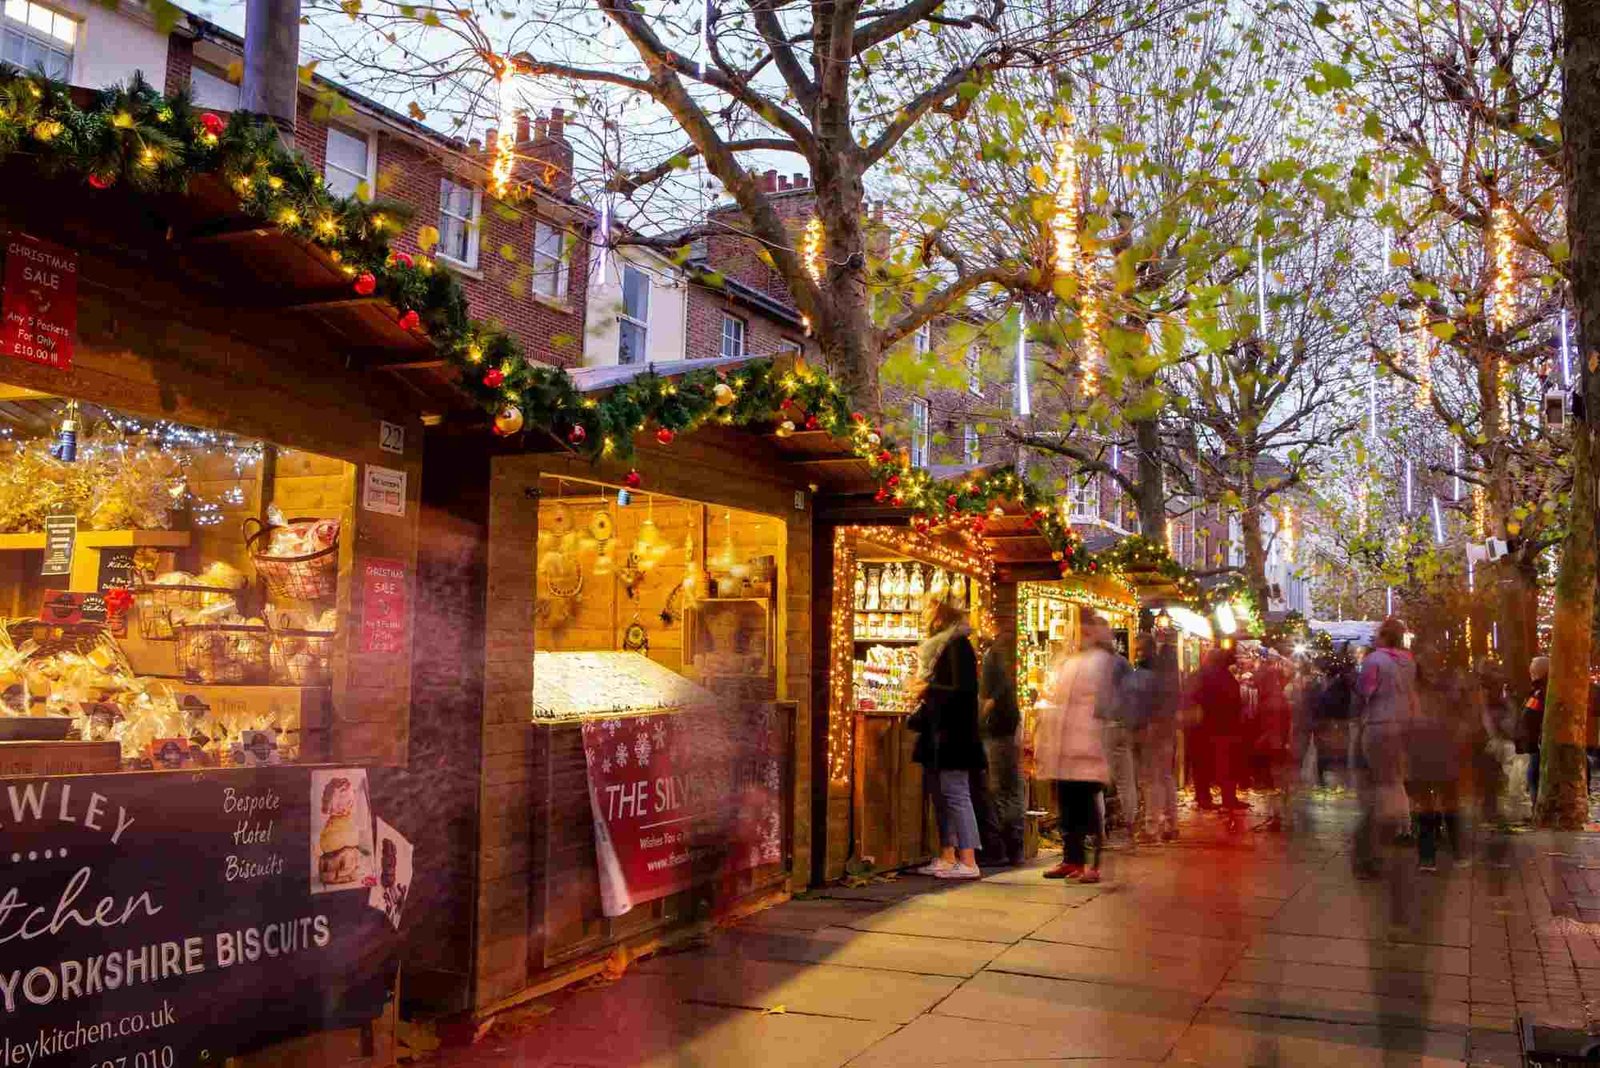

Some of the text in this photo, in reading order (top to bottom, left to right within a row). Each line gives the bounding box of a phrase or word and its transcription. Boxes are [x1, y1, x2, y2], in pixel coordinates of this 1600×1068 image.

[8, 242, 77, 273] CHRISTMAS
[23, 266, 60, 290] SALE
[7, 311, 25, 326] Any
[28, 316, 35, 326] 5
[17, 328, 56, 350] For Only
[382, 424, 401, 450] 22
[365, 565, 404, 578] CHRISTMAS
[373, 581, 397, 595] SALE
[0, 781, 136, 844] WLEY
[223, 787, 280, 817] Bespoke
[605, 780, 648, 821] THE
[232, 819, 273, 846] Hotel
[225, 853, 284, 882] Biscuits
[0, 914, 331, 1013] YORKSHIRE BISCUITS
[0, 999, 175, 1068] leykitchen.co.uk
